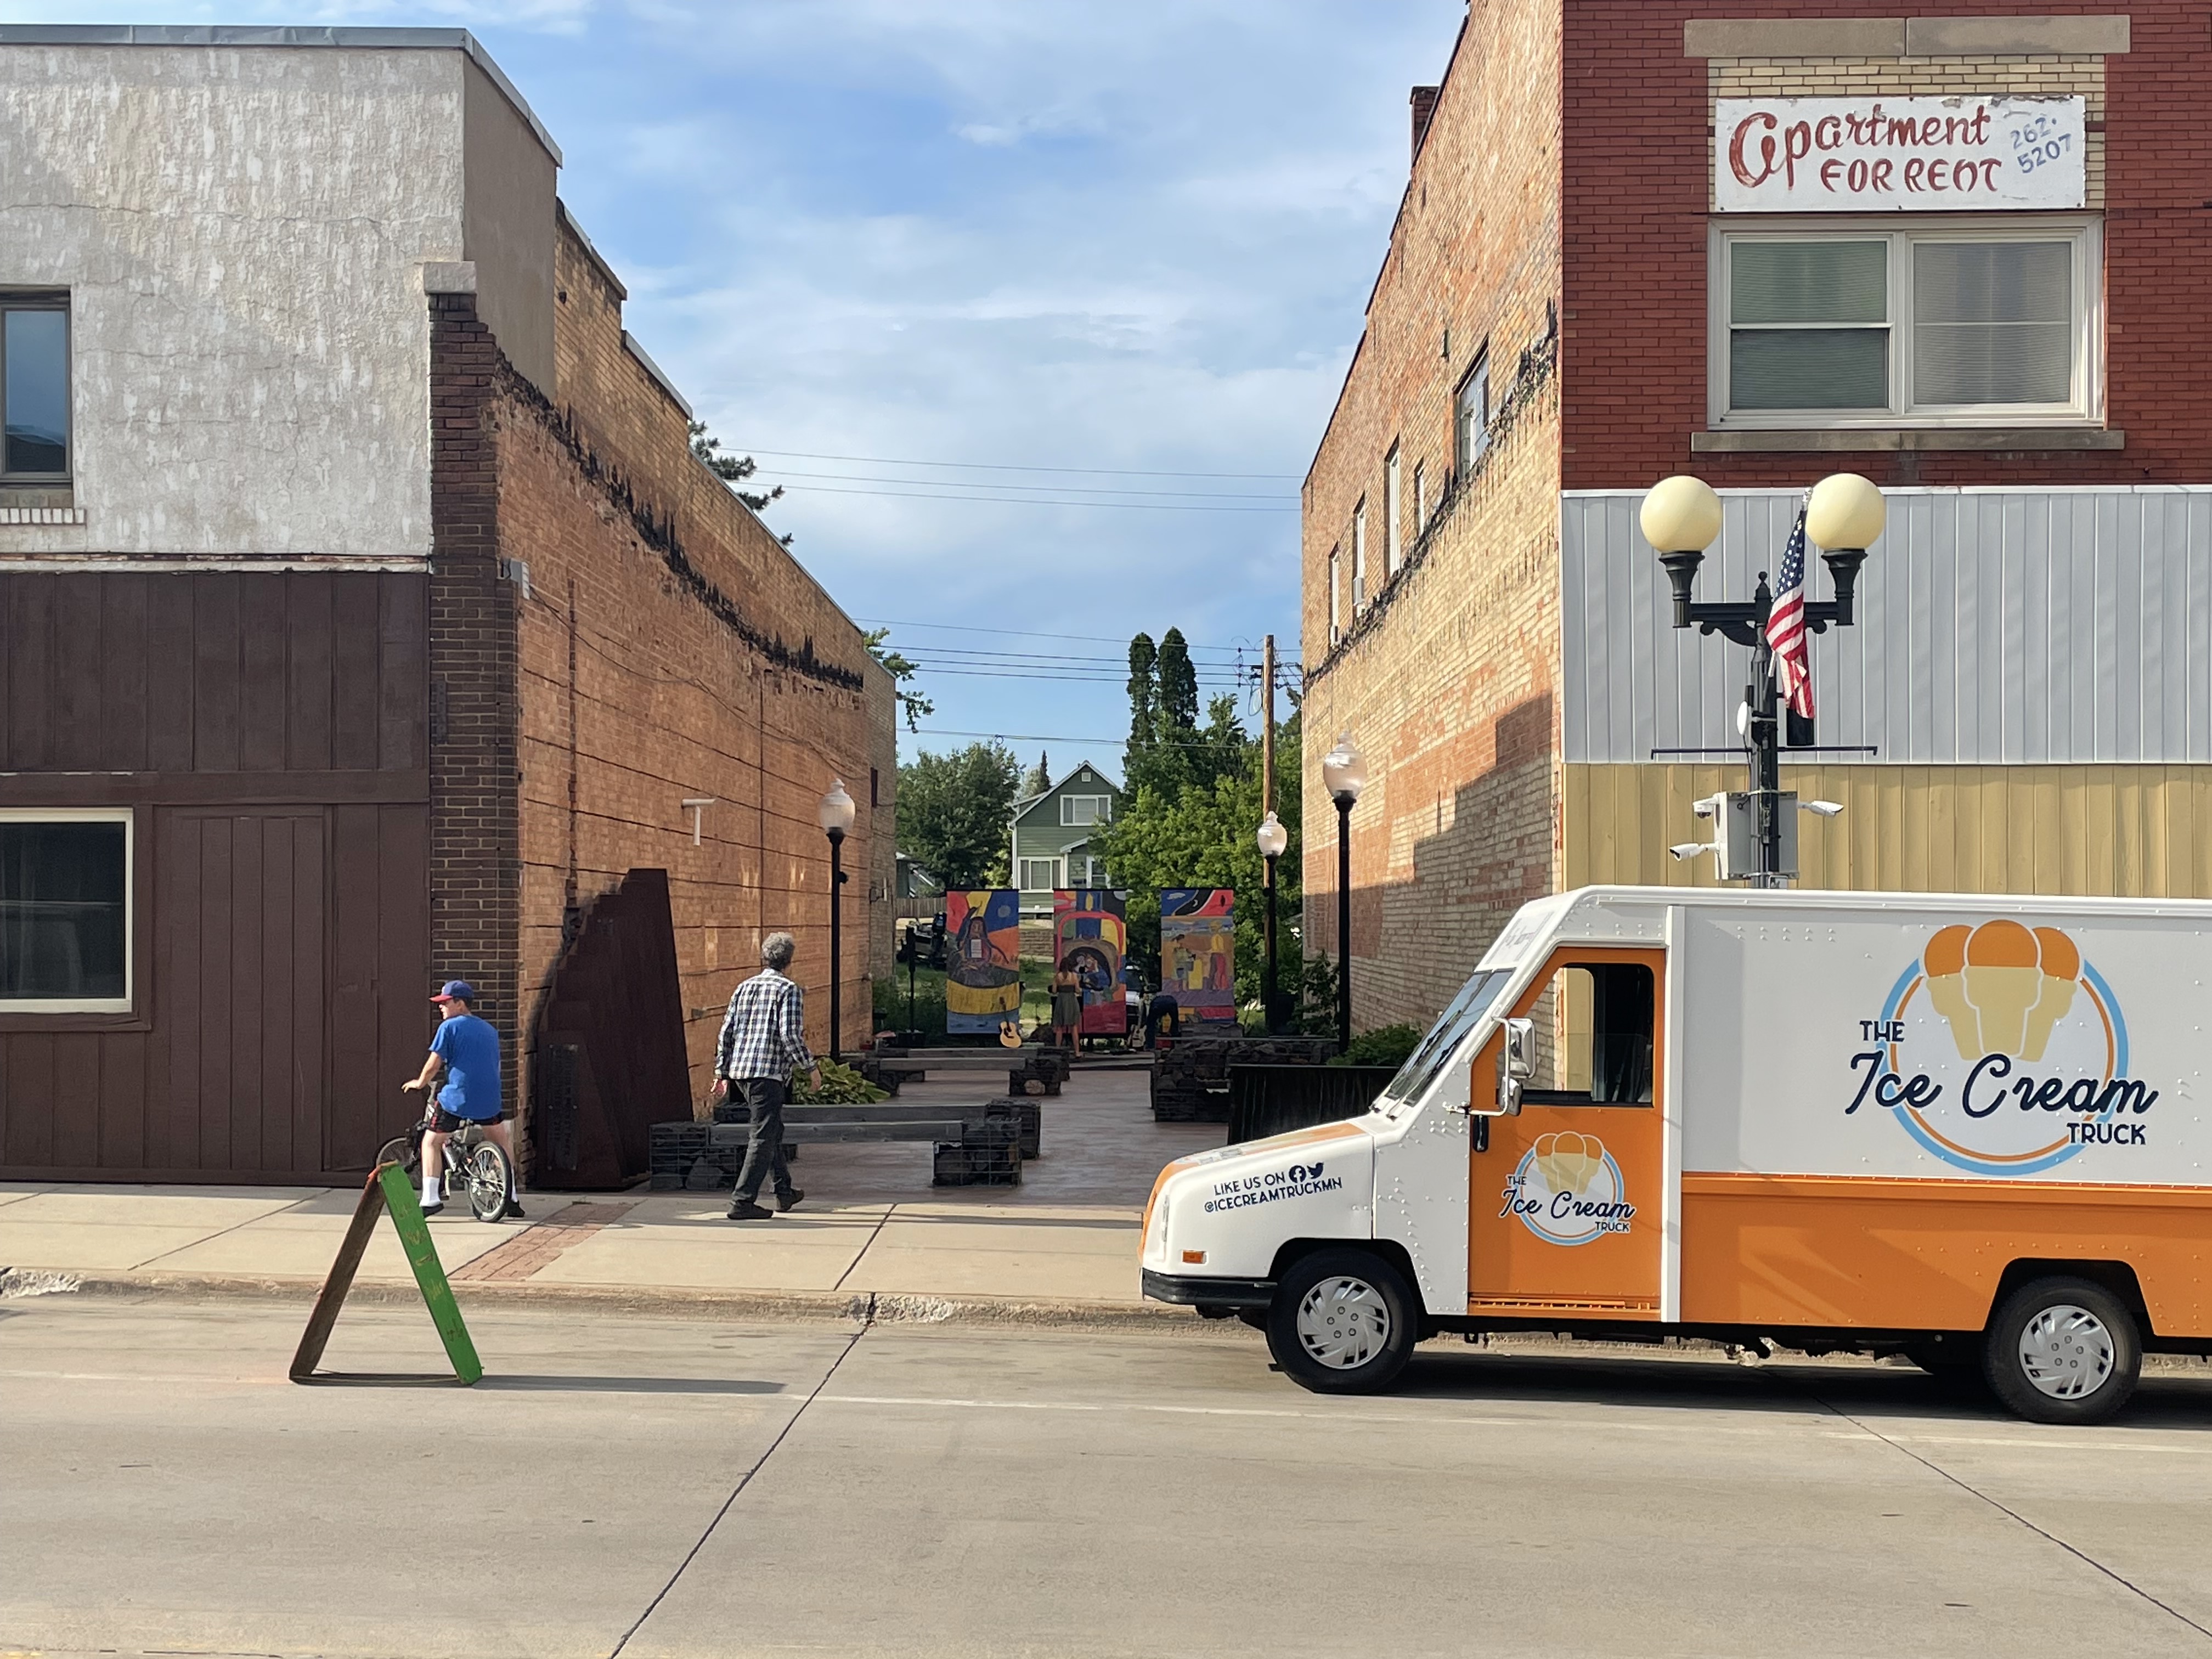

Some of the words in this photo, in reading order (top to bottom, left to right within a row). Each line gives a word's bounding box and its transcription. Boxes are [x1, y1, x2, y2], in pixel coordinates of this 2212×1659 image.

[2017, 133, 2073, 173] 5207
[1820, 157, 1896, 193] FOR
[1904, 157, 2003, 193] RENT
[1859, 1020, 1905, 1042] THE
[1845, 1050, 1943, 1115] Ice
[1962, 1053, 2159, 1118] Cream
[2067, 1122, 2146, 1145] TRUCK
[1214, 1181, 1240, 1195] LIKE
[1243, 1177, 1261, 1189] US
[1265, 1172, 1286, 1186] ON
[1508, 1176, 1527, 1185] THE
[1204, 1177, 1342, 1212] @ICECREAMTRUCKMN
[1500, 1189, 1543, 1217] Ice
[1550, 1191, 1635, 1219] Cream
[1595, 1221, 1629, 1232] TRUCK
